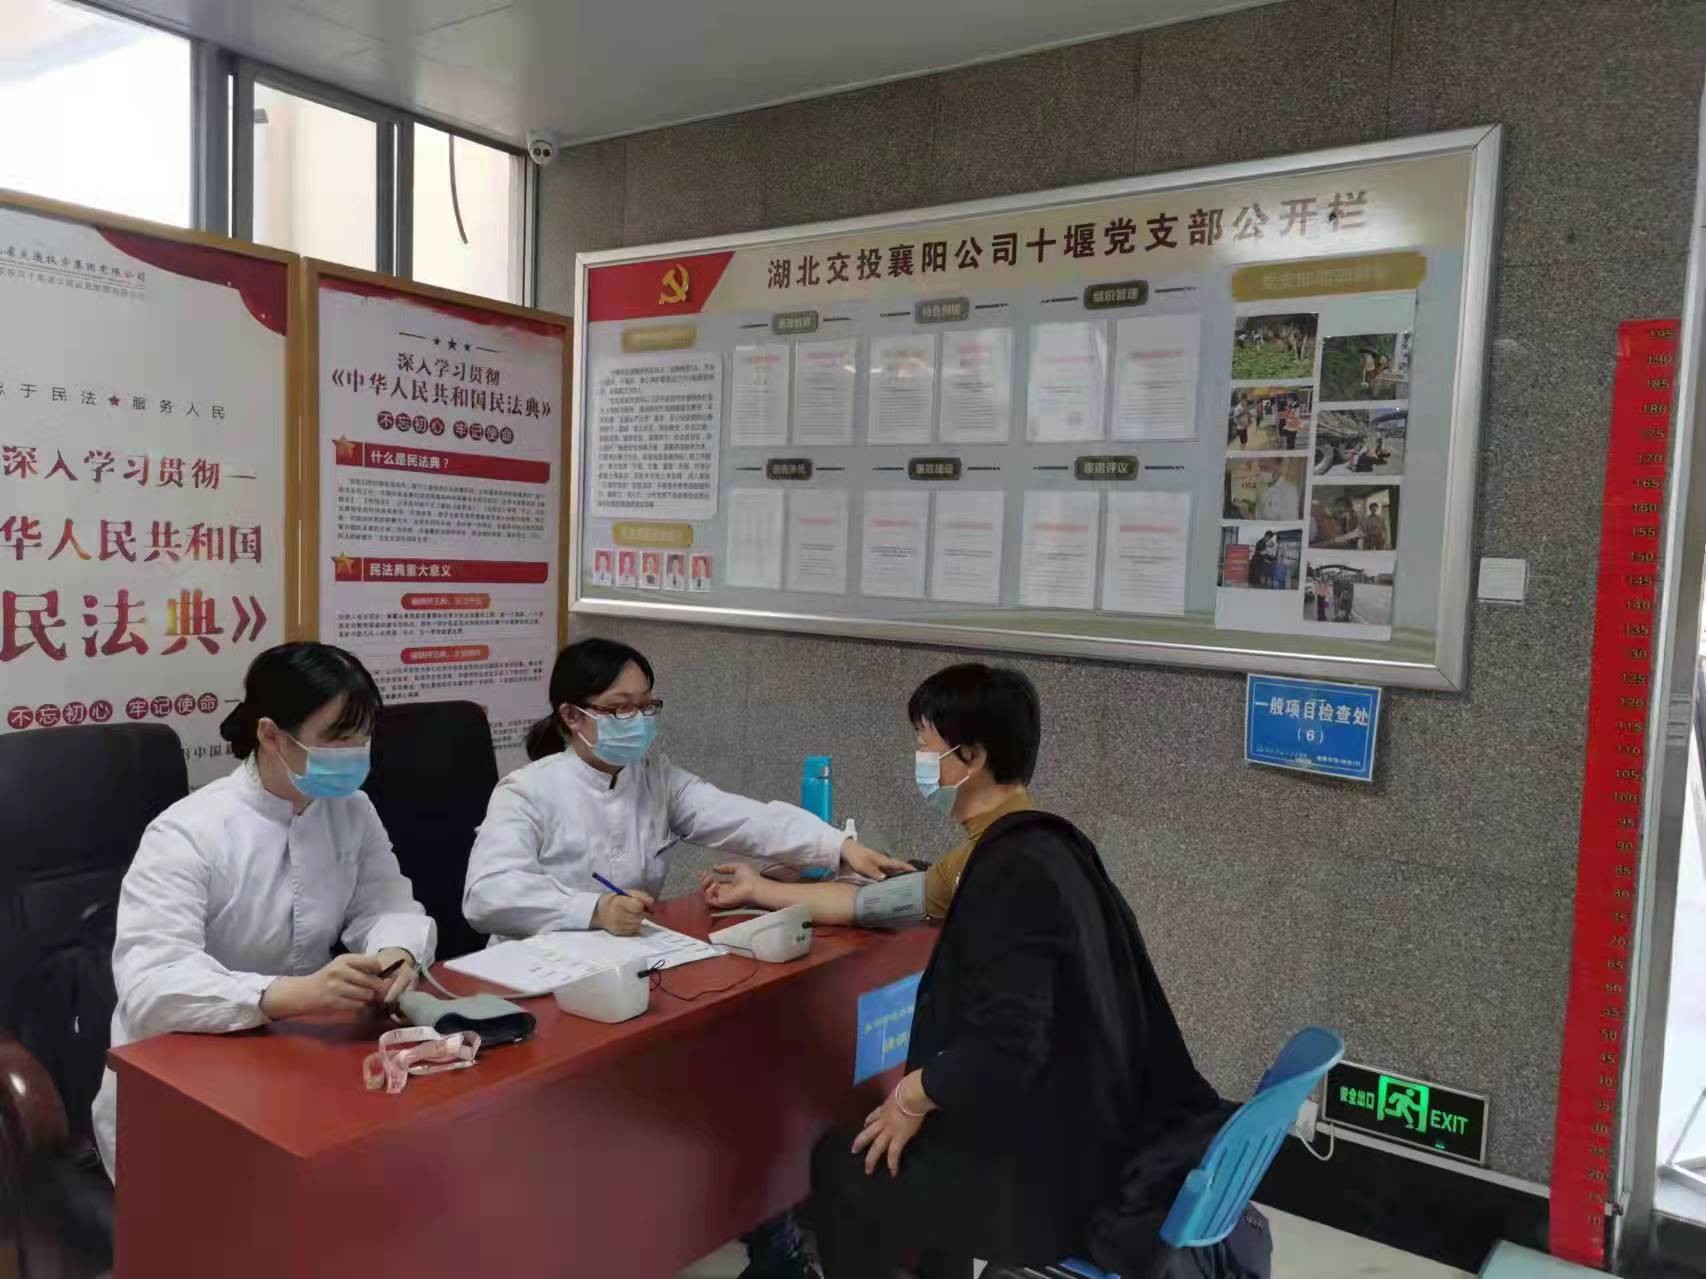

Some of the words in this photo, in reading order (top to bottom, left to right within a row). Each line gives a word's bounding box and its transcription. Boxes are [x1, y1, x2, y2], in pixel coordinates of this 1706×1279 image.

[767, 190, 1367, 289] 湖北交投襄阳公司十堰党支部公开栏
[398, 352, 500, 386] 深入学习贯彻
[332, 368, 550, 419] 《中华人民共和国民法典》
[132, 396, 225, 420] 服务人民
[378, 411, 445, 435] 不忘初心
[453, 420, 513, 444] 牢记使命
[2, 446, 220, 489] 深入学习贯彻
[370, 450, 449, 469] 什么是民法典？
[1633, 503, 1657, 513] 160
[1632, 527, 1656, 537] 155
[369, 563, 452, 577] 民法典重大意义
[0, 589, 267, 662] 民法典》
[1625, 624, 1649, 635] 135
[9, 702, 112, 728] 不忘初心
[127, 693, 217, 718] 牢记使命
[1255, 696, 1369, 726] 一般项目检查处
[1601, 1029, 1618, 1041] 50
[1430, 1109, 1469, 1135] EXIT
